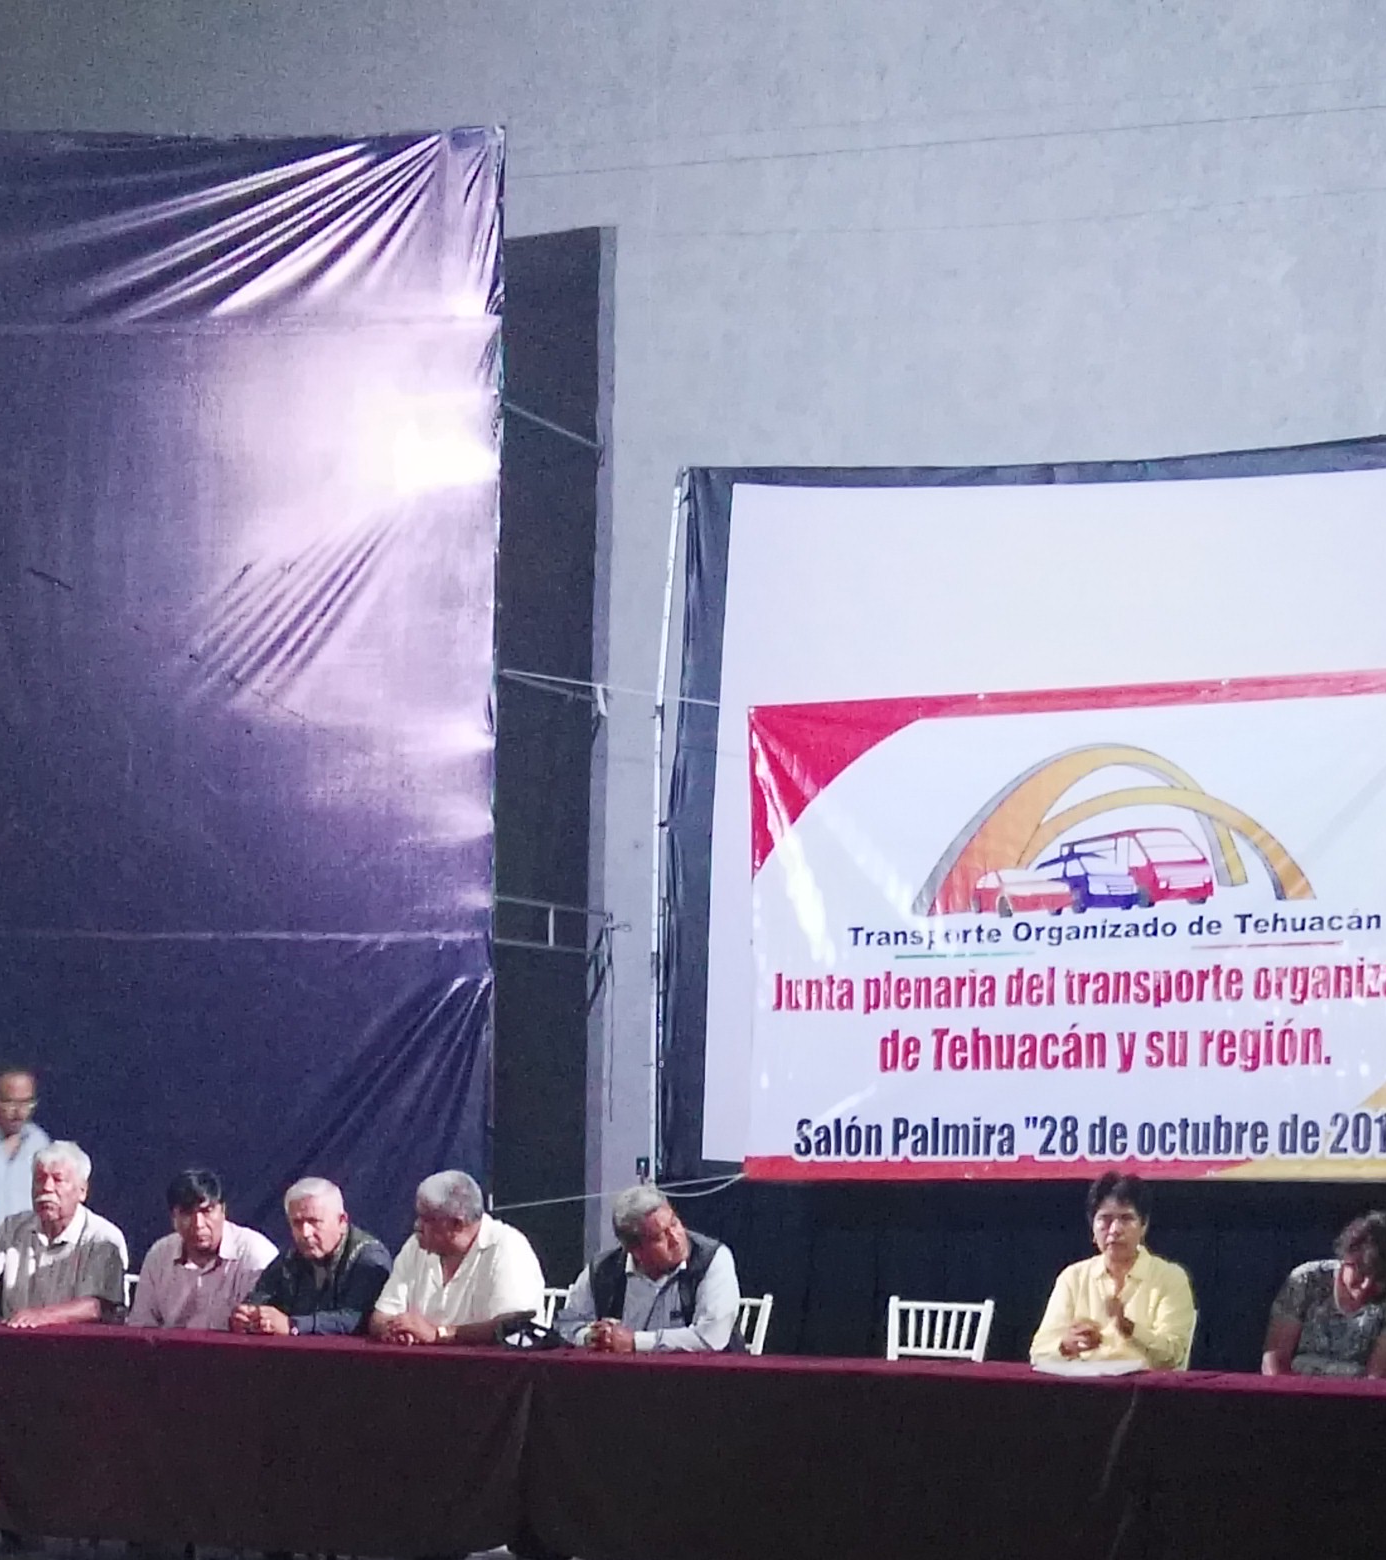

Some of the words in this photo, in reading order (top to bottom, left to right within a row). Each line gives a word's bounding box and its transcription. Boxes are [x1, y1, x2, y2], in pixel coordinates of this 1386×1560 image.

[1188, 915, 1222, 936] de
[1234, 909, 1382, 935] Tehuacán
[772, 972, 854, 1012] Junta
[863, 969, 996, 1015] plenaria
[1005, 966, 1056, 1008] del
[1065, 964, 1244, 1008] transporte
[879, 1028, 921, 1073] de
[931, 1023, 1107, 1072] Tehuacán
[1116, 1030, 1137, 1074] y
[1145, 1028, 1188, 1070] su
[1199, 1018, 1332, 1072] región.
[793, 1116, 882, 1157] Salón
[891, 1116, 1015, 1157] Palmira
[1024, 1116, 1079, 1157] "28
[1088, 1115, 1128, 1156] de
[1137, 1114, 1269, 1156] octubre
[1277, 1114, 1320, 1156] de
